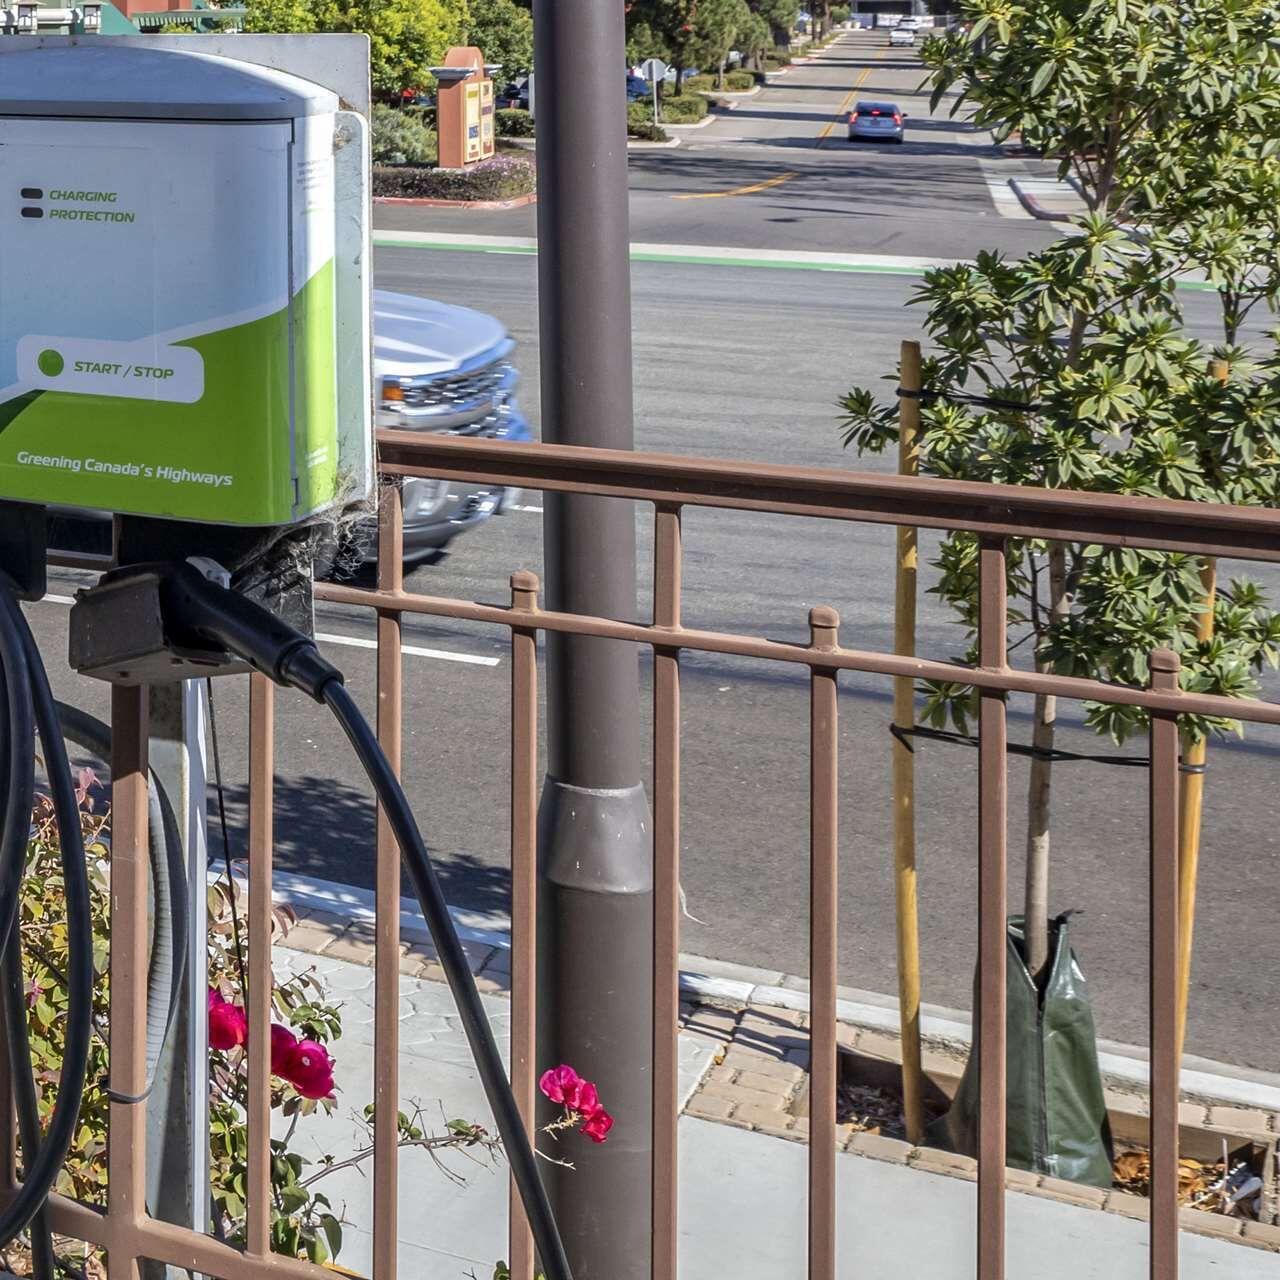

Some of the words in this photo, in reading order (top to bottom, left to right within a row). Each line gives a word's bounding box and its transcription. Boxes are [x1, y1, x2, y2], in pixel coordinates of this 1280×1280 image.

[49, 189, 117, 203] CHARGING
[49, 208, 135, 223] PROTECTION
[74, 360, 122, 374] START
[134, 366, 174, 379] STOP
[17, 451, 81, 472] Greening
[155, 466, 233, 487] Highways
